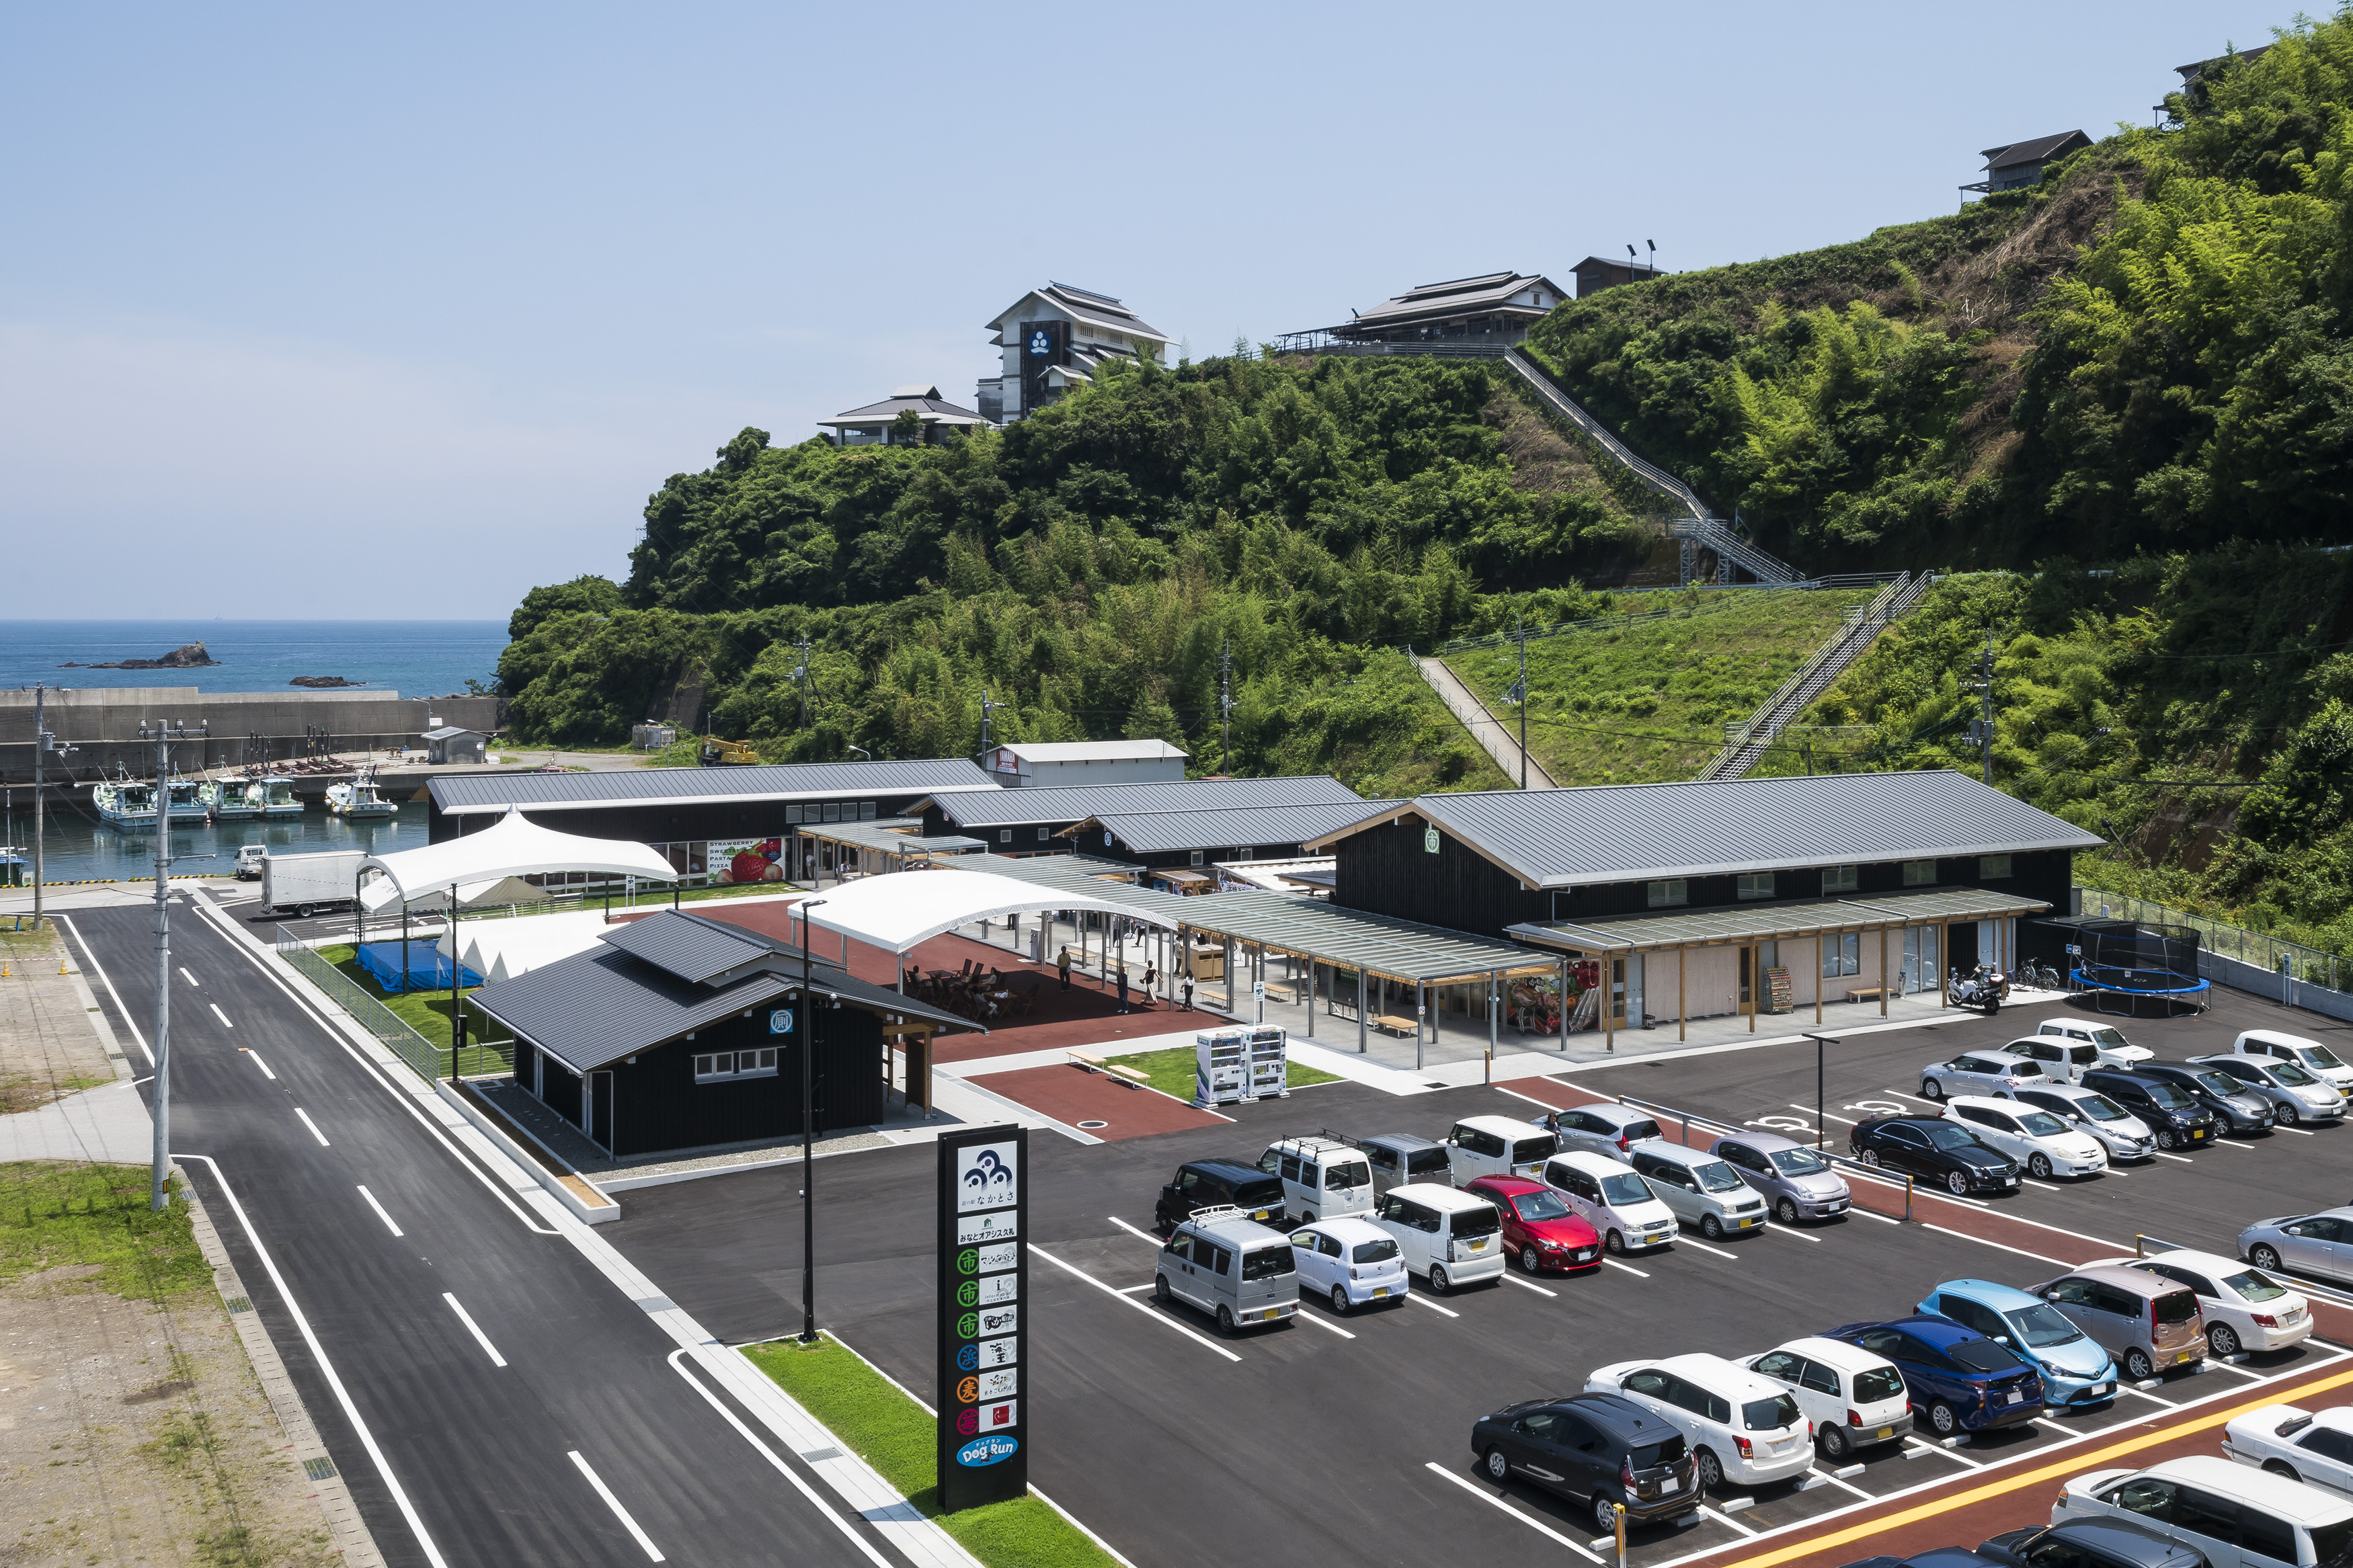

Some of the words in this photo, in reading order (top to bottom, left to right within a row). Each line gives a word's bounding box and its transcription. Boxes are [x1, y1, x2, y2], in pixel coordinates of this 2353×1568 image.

[999, 750, 1015, 763] YAMAHA
[1427, 832, 1438, 850] 市
[977, 1191, 1014, 1205] なかとさ
[959, 1227, 1014, 1243] みなとオアシス久礼
[961, 1252, 978, 1272] 市
[961, 1284, 978, 1304] 市
[984, 1291, 1012, 1299] Information
[961, 1317, 978, 1335] 市
[961, 1348, 978, 1366] 浜
[961, 1380, 978, 1399] 麦
[975, 1438, 1001, 1448] ドッグラン
[963, 1446, 988, 1463] Dog
[990, 1443, 1014, 1455] Run
